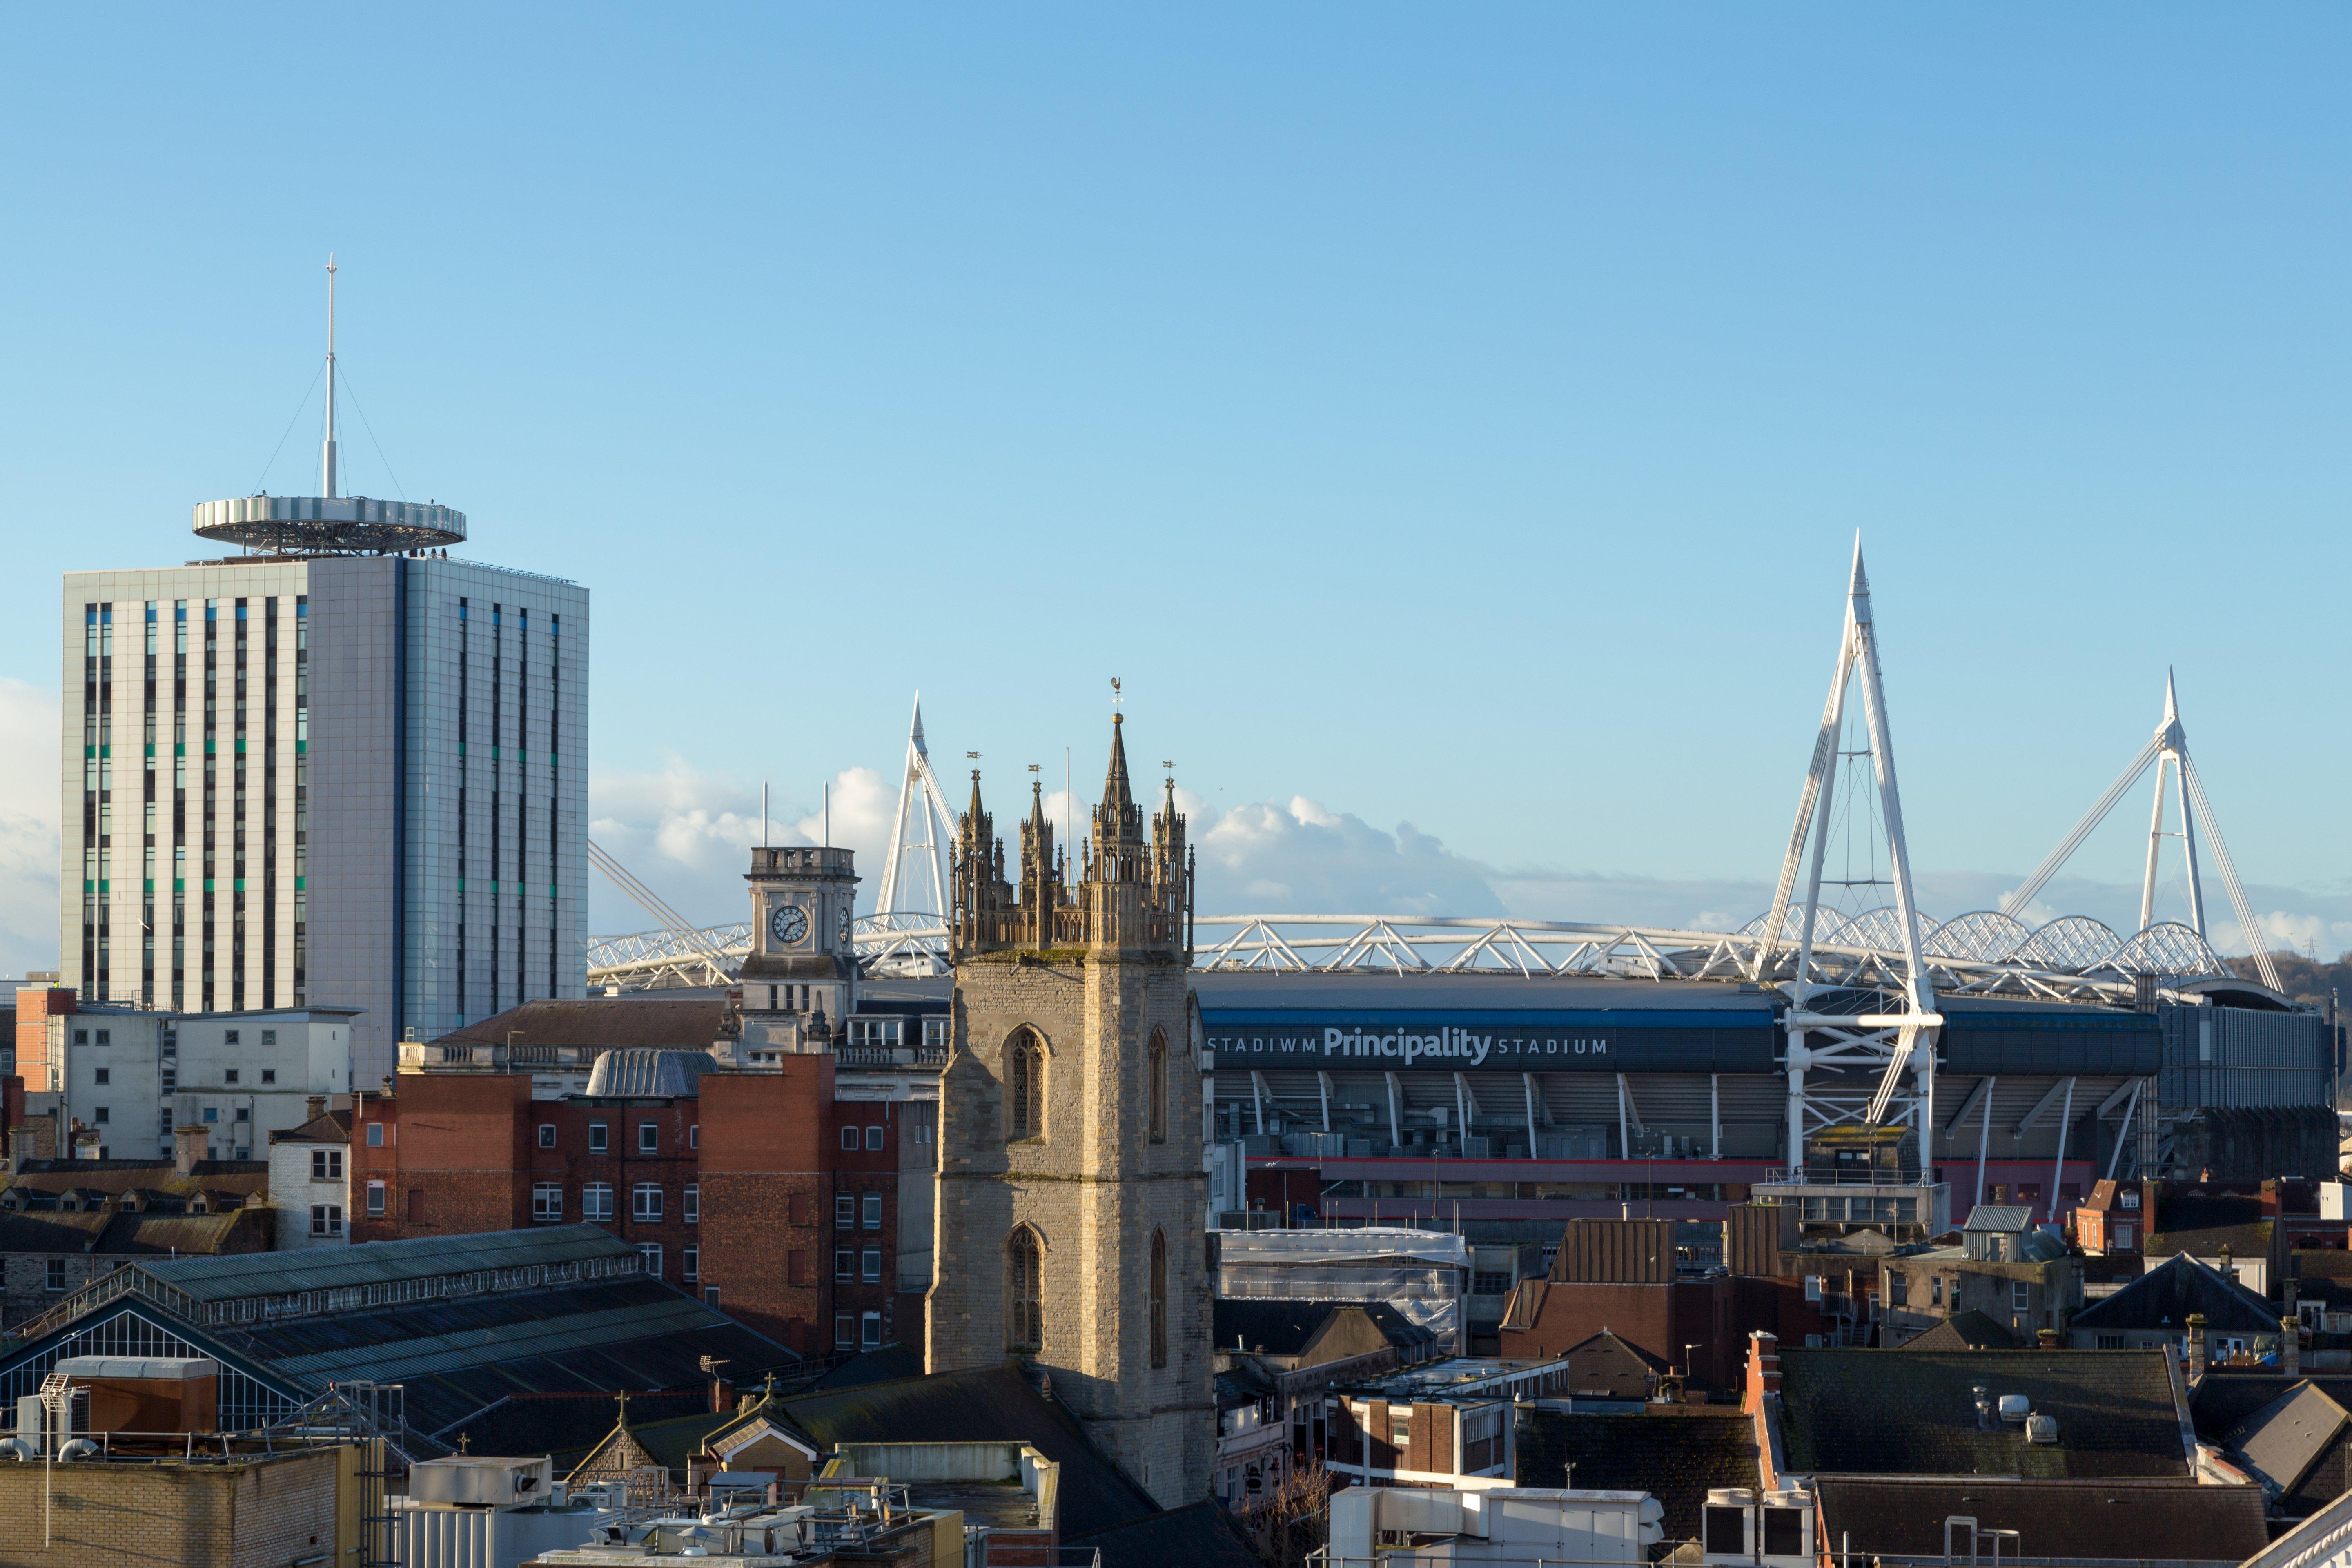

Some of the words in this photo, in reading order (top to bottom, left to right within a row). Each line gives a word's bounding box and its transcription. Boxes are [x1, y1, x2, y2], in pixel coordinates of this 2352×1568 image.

[1207, 1038, 1316, 1052] STADIWM
[1324, 1027, 1492, 1065] Principality
[1499, 1039, 1606, 1054] STADIUM
